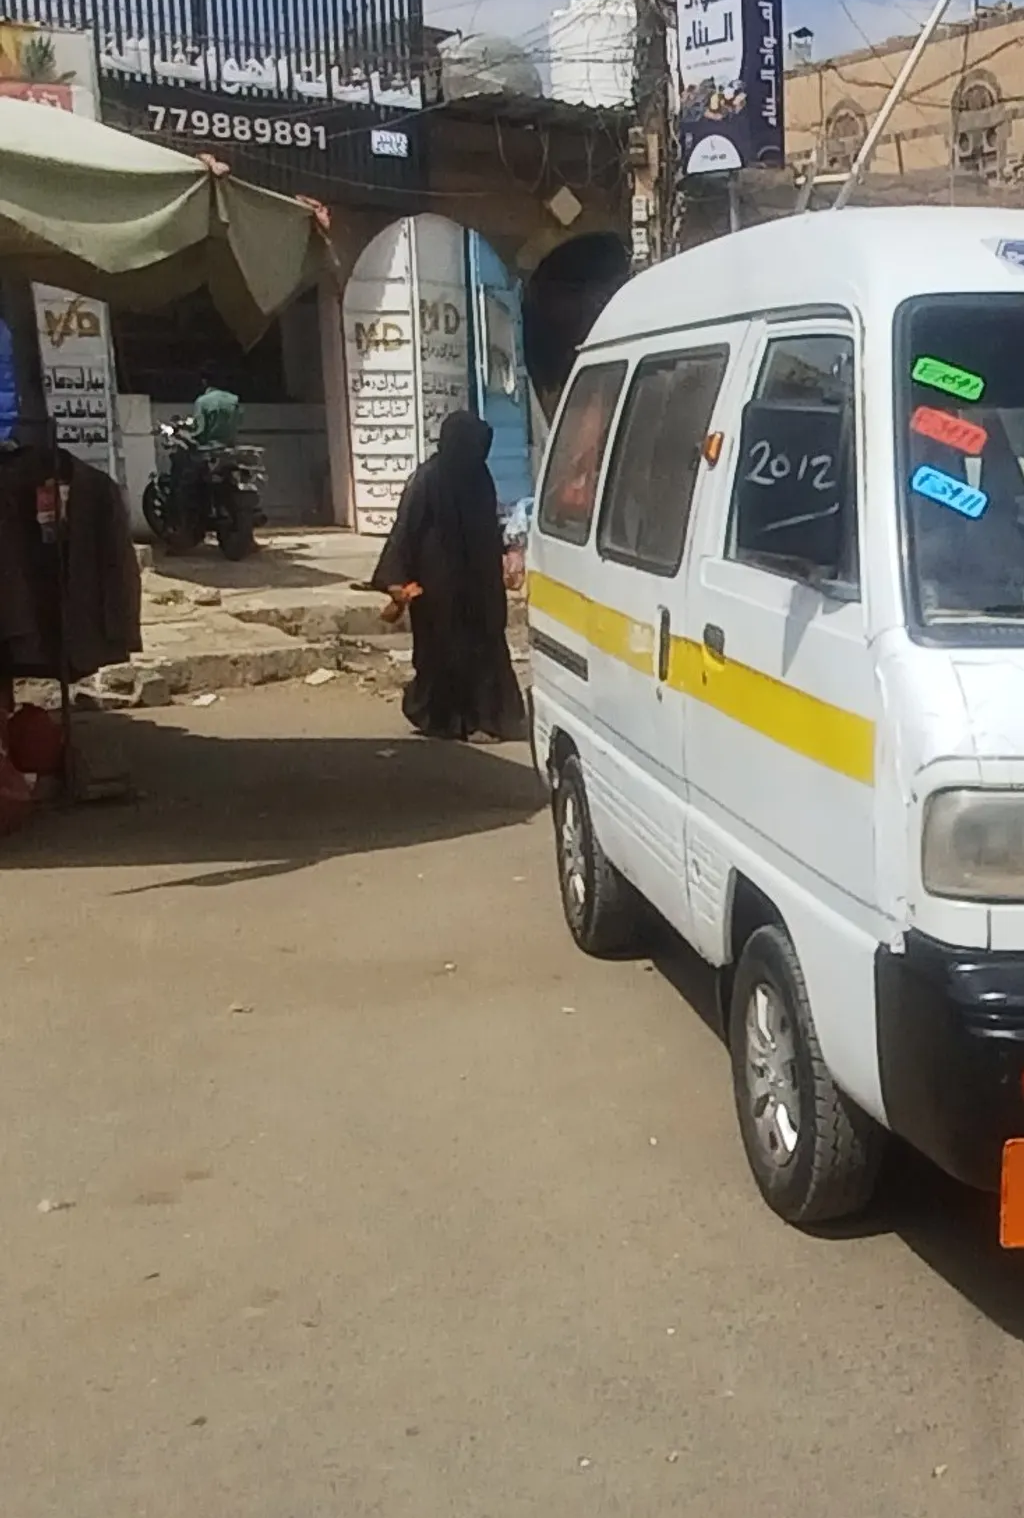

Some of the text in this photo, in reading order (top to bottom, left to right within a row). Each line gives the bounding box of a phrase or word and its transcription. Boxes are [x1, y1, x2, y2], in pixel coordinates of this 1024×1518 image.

[684, 11, 734, 56] البناء
[148, 104, 327, 150] 779889891
[745, 440, 836, 491] 2012
